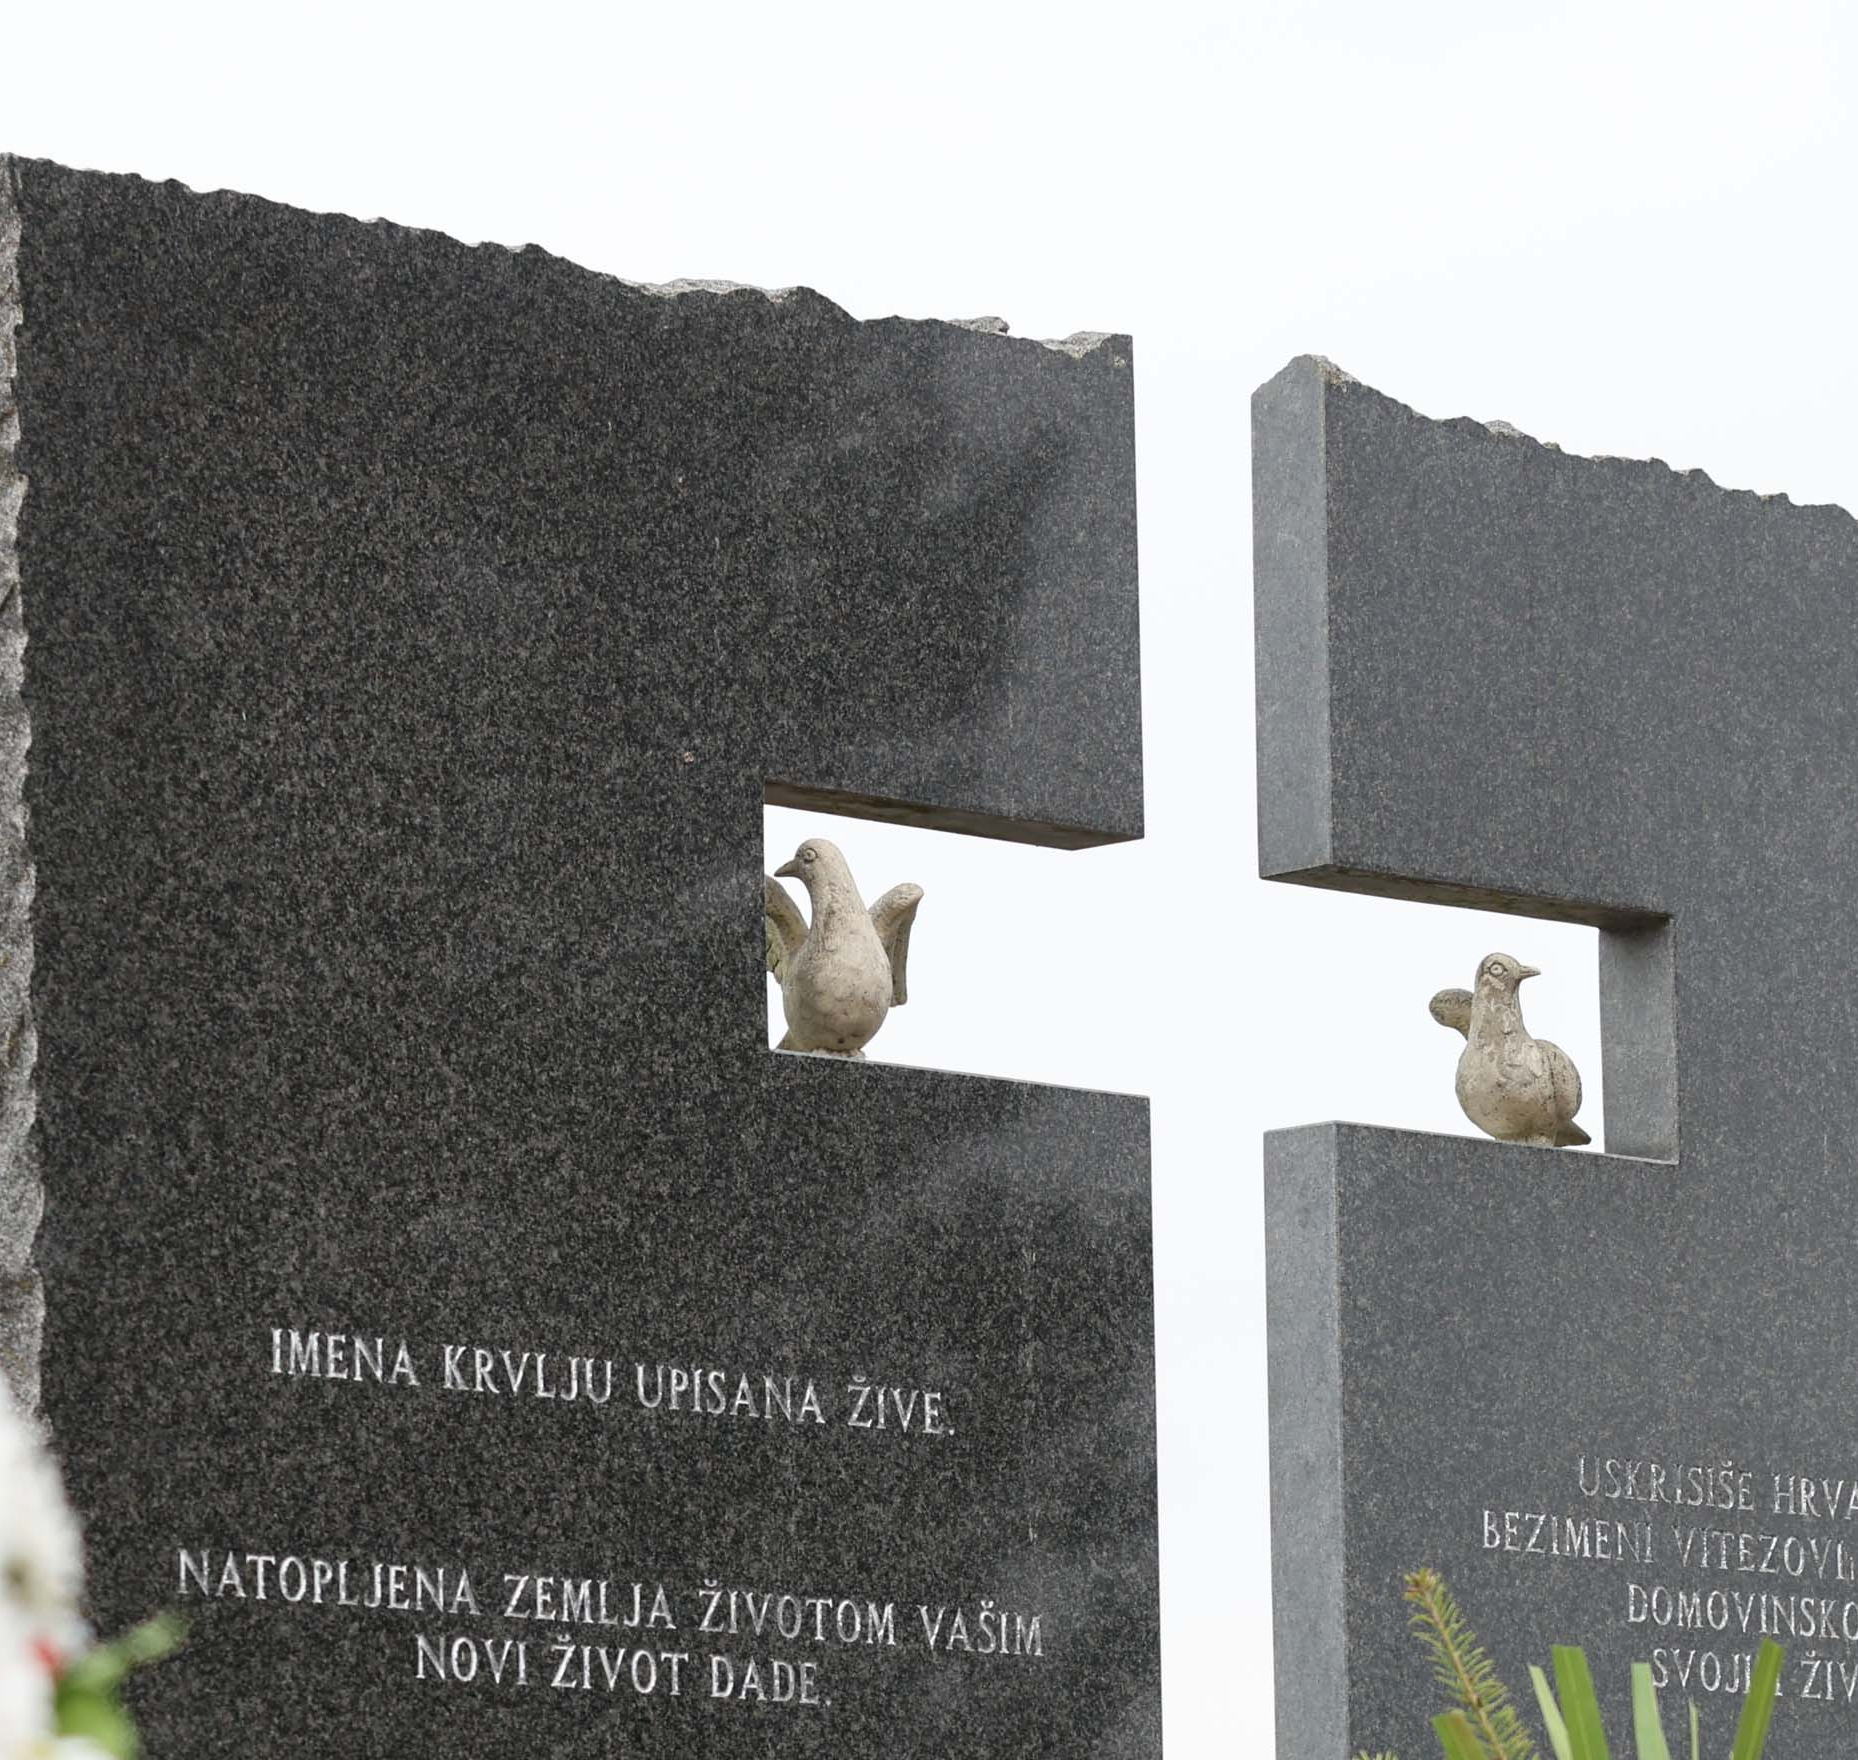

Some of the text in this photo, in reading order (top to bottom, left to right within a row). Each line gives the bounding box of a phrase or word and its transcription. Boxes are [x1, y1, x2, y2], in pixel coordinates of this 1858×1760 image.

[270, 1324, 957, 1436] IMENA KRVLJU UPISANA ŽIVE.
[1577, 1454, 1755, 1513] USKRISIŠE
[1482, 1509, 1654, 1565] BEZIMENI
[1671, 1524, 1847, 1583] VITEZOVI
[176, 1548, 1045, 1657] NATOPLJENA ZEMLJA ŽIVOTOM VAŠIM
[414, 1634, 833, 1708] NOVI ŽIVOT DADE.
[1650, 1645, 1784, 1697] SVOJI
